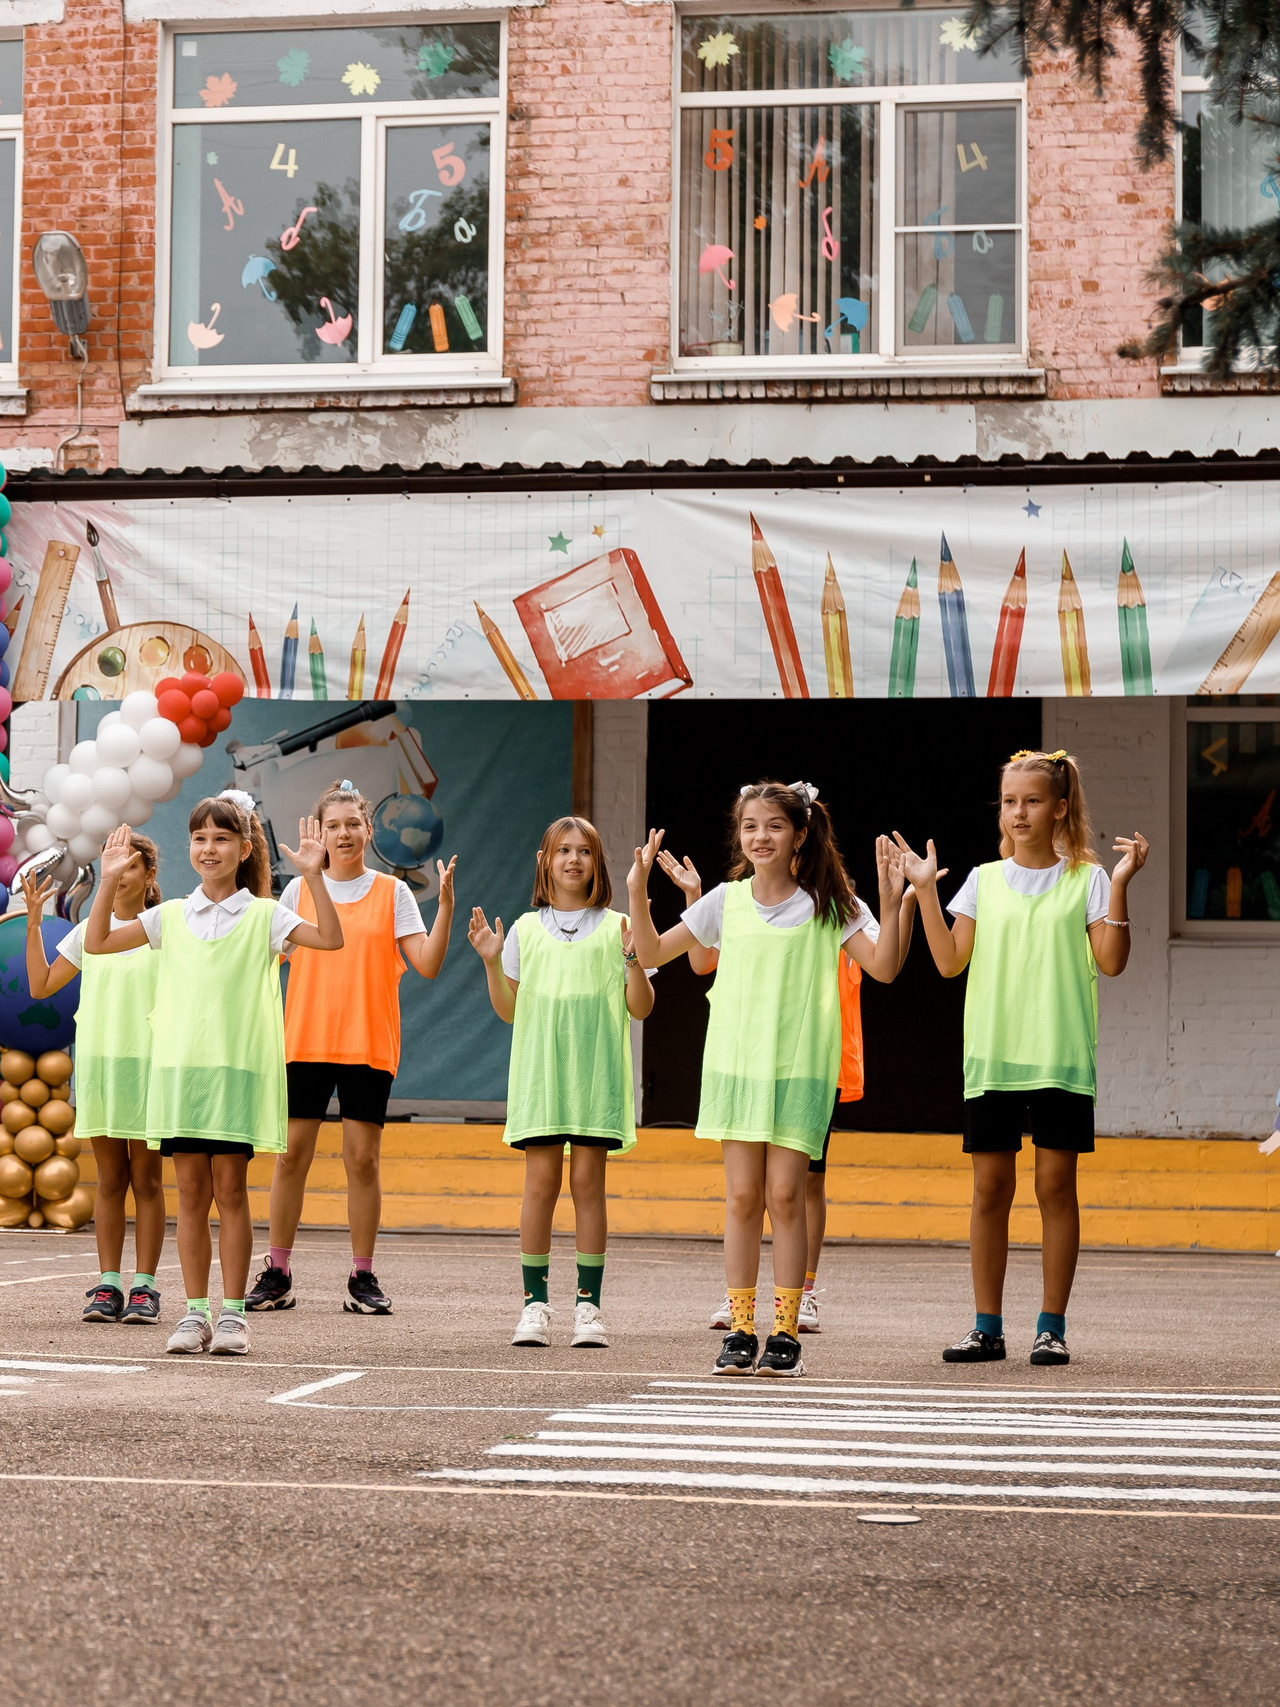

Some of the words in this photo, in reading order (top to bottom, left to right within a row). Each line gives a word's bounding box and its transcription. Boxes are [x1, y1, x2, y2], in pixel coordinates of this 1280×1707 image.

[269, 143, 299, 178] 4
[431, 142, 465, 186] 5
[704, 129, 735, 171] 5
